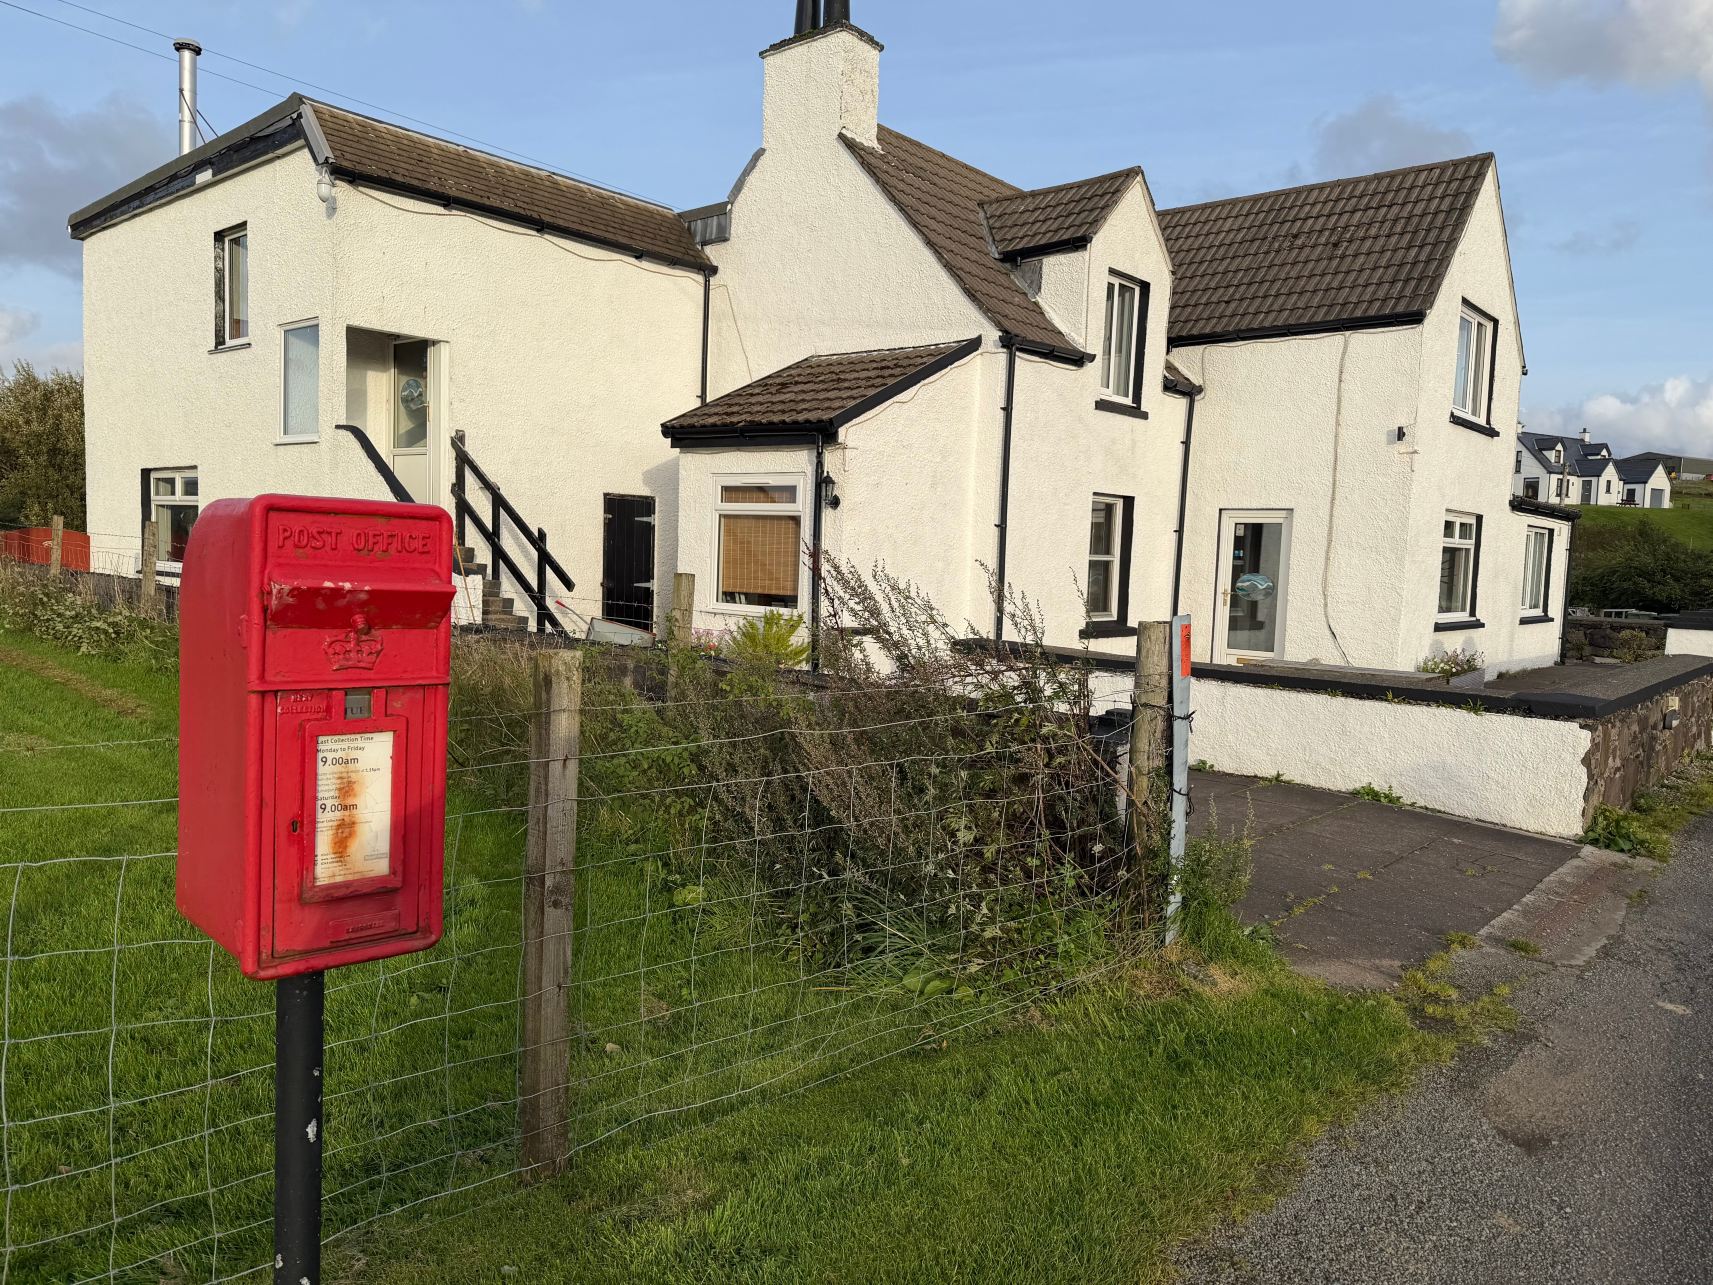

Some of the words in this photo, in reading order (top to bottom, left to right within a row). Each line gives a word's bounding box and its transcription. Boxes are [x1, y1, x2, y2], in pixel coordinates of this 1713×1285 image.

[277, 525, 342, 549] POST
[352, 529, 431, 554] OFFICE
[330, 736, 359, 744] Collection
[317, 746, 339, 754] Monday
[321, 756, 359, 767] 9.00am
[319, 803, 358, 814] 9.00am
